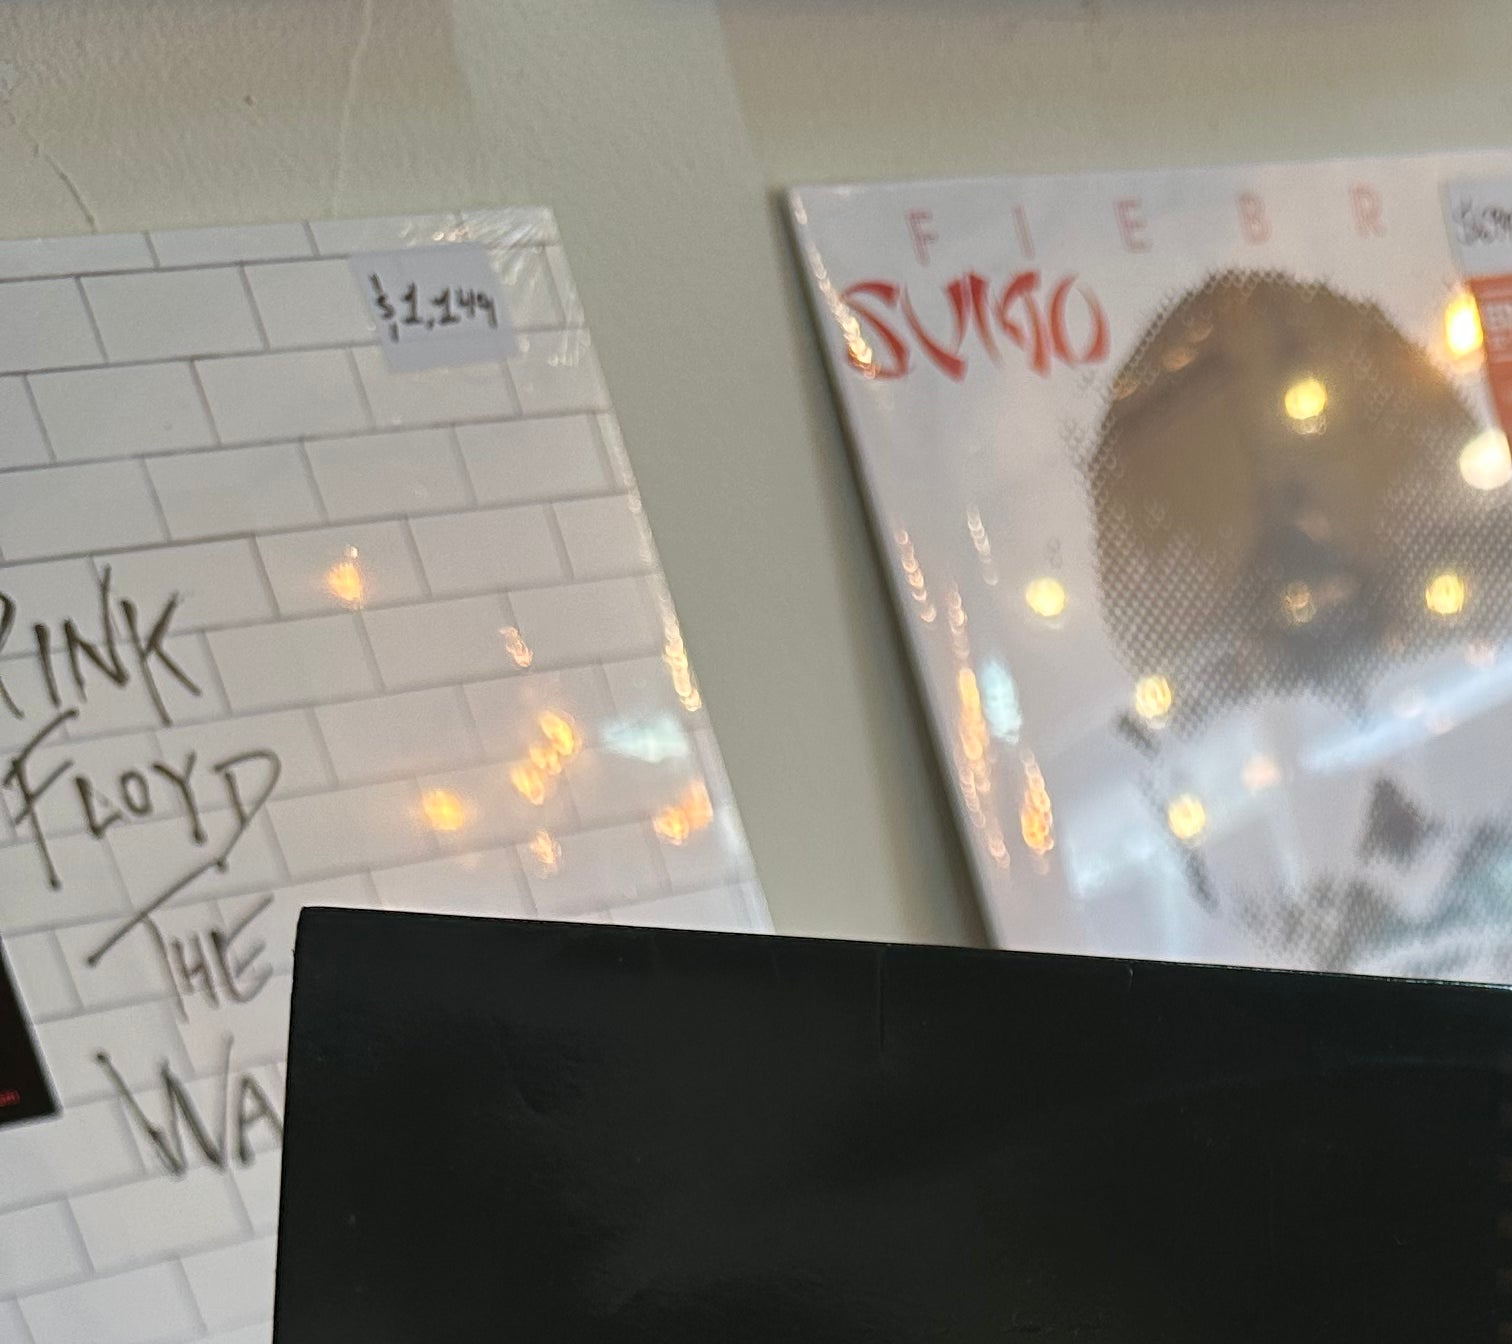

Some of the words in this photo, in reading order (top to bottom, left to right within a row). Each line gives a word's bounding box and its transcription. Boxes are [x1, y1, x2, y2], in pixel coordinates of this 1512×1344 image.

[906, 183, 1388, 266] FIEBR
[2, 706, 282, 890] FLOYD
[85, 862, 275, 1024] THE
[96, 1033, 284, 1180] WA
